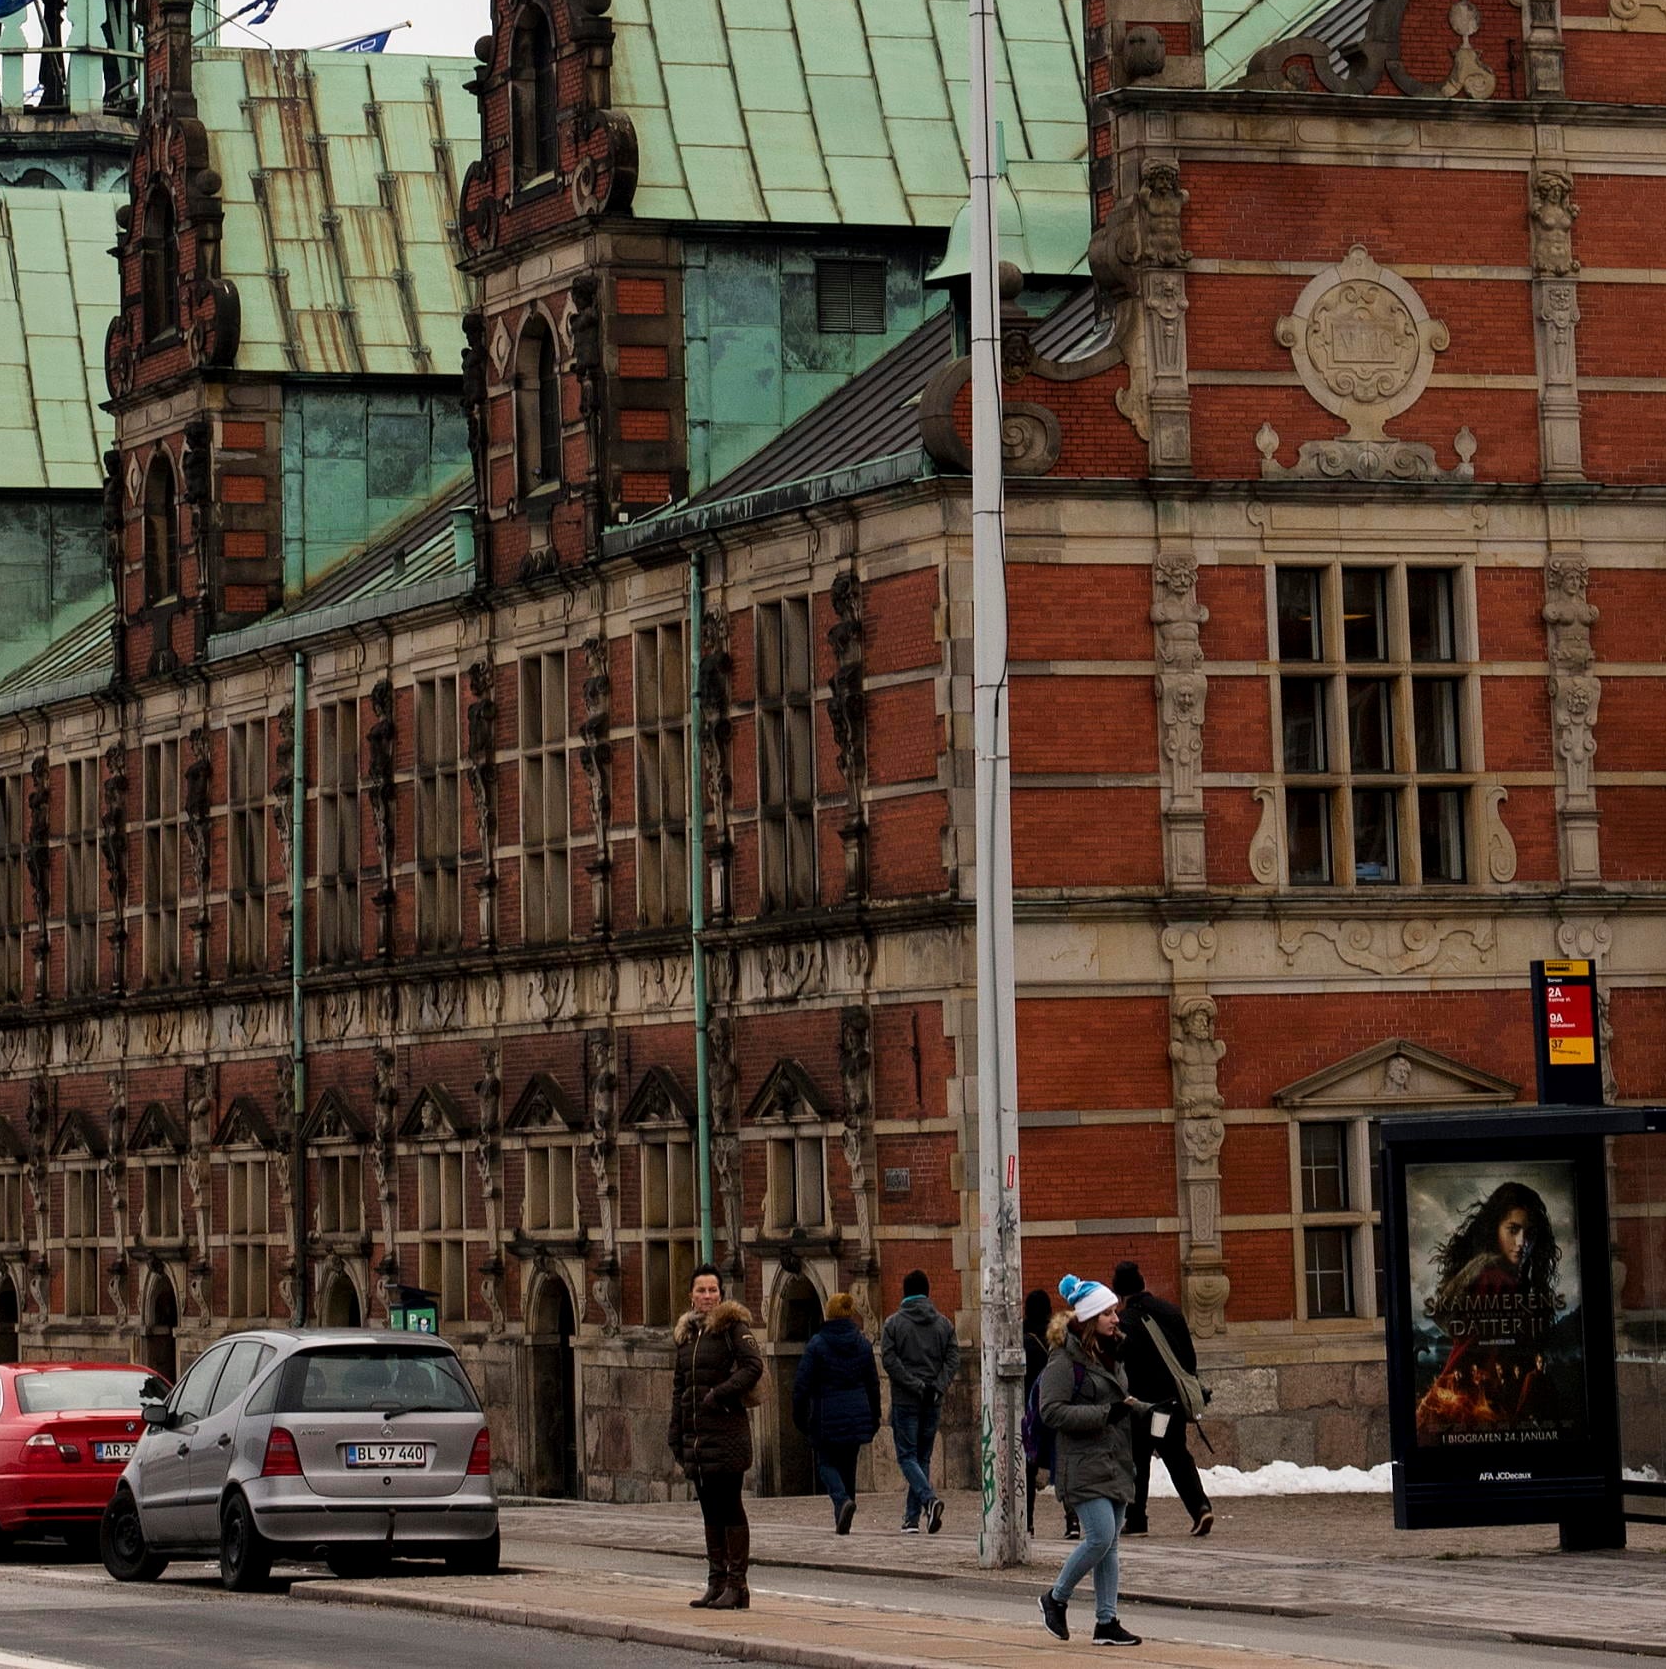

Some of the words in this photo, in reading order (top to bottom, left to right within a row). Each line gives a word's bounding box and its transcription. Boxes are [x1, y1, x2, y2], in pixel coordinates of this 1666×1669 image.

[1548, 987, 1562, 997] 2A
[1549, 1013, 1564, 1023] 9A
[1551, 1039, 1563, 1049] 37
[1423, 1293, 1566, 1317] SKAMMERENS
[409, 1313, 417, 1325] P
[1450, 1318, 1525, 1336] DATTER
[1448, 1433, 1501, 1444] BIOGRAFEN
[1520, 1431, 1558, 1443] JANUAR
[105, 1444, 121, 1457] AR
[358, 1447, 375, 1461] BL
[379, 1447, 395, 1460] 97
[399, 1446, 423, 1460] 440
[1479, 1472, 1494, 1481] AFA
[1495, 1471, 1532, 1480] JCDecaux
